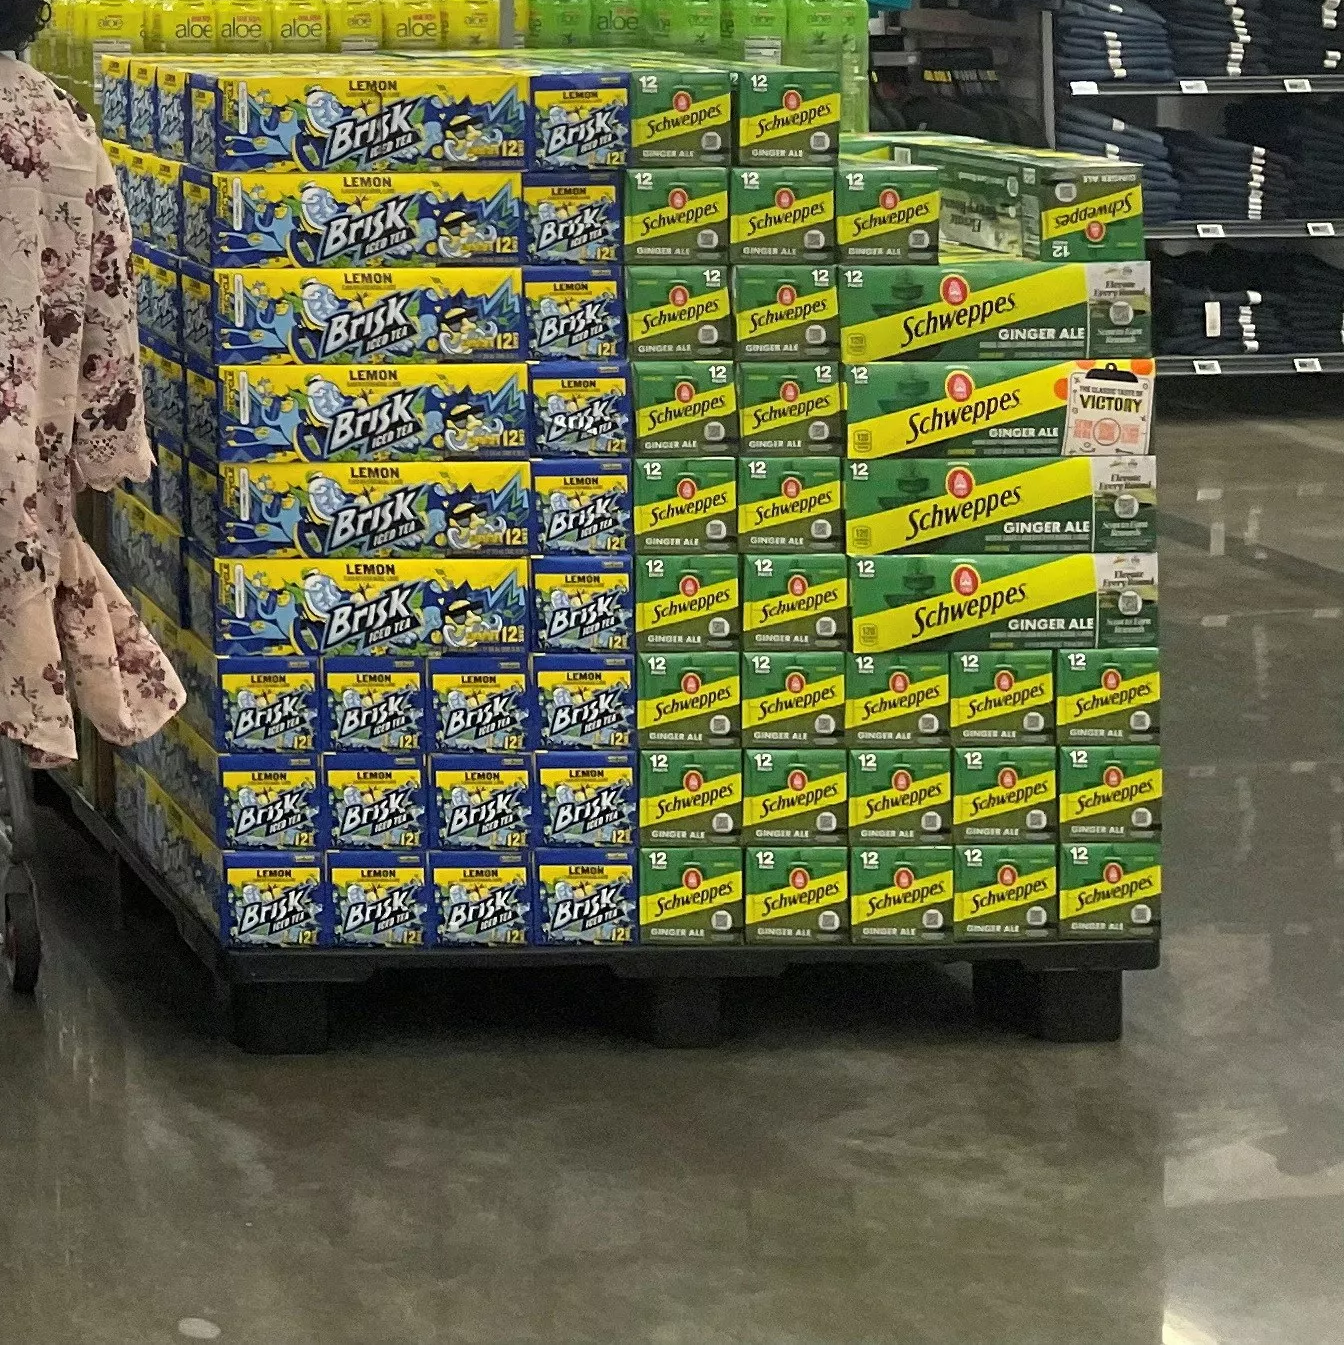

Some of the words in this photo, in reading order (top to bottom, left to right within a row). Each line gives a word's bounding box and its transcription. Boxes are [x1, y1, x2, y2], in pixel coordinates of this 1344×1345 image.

[221, 17, 262, 38] aloe
[280, 18, 323, 38] aloe
[396, 17, 437, 38] aloe
[348, 80, 398, 91] LEMON
[639, 76, 657, 88] 12
[646, 103, 723, 138] Schweppes
[755, 100, 831, 138] Schweppes
[342, 176, 392, 187] LEMON
[853, 200, 929, 233] Schweppes
[845, 270, 863, 283] 12
[903, 291, 1017, 347] Schweppes
[998, 327, 1056, 341] GINGER
[1059, 327, 1085, 340] ALE
[348, 370, 398, 381] LEMON
[1080, 394, 1142, 413] VICTORY
[906, 389, 1021, 444] Schweppes
[906, 485, 1022, 541] Schweppes
[1003, 521, 1061, 535] GINGER
[1063, 521, 1090, 534] ALE
[346, 563, 396, 574] LEMON
[912, 582, 1027, 638] Schweppes
[1008, 618, 1065, 631] GINGER
[1068, 617, 1094, 631] ALE
[1068, 654, 1086, 667] 12
[250, 675, 287, 684] LEMON
[654, 684, 732, 720] Schweppes
[1076, 682, 1152, 717] Schweppes
[866, 782, 943, 816] Schweppes
[360, 870, 397, 879] LEMON
[655, 882, 733, 917] Schweppes
[1077, 875, 1154, 911] Schweppes
